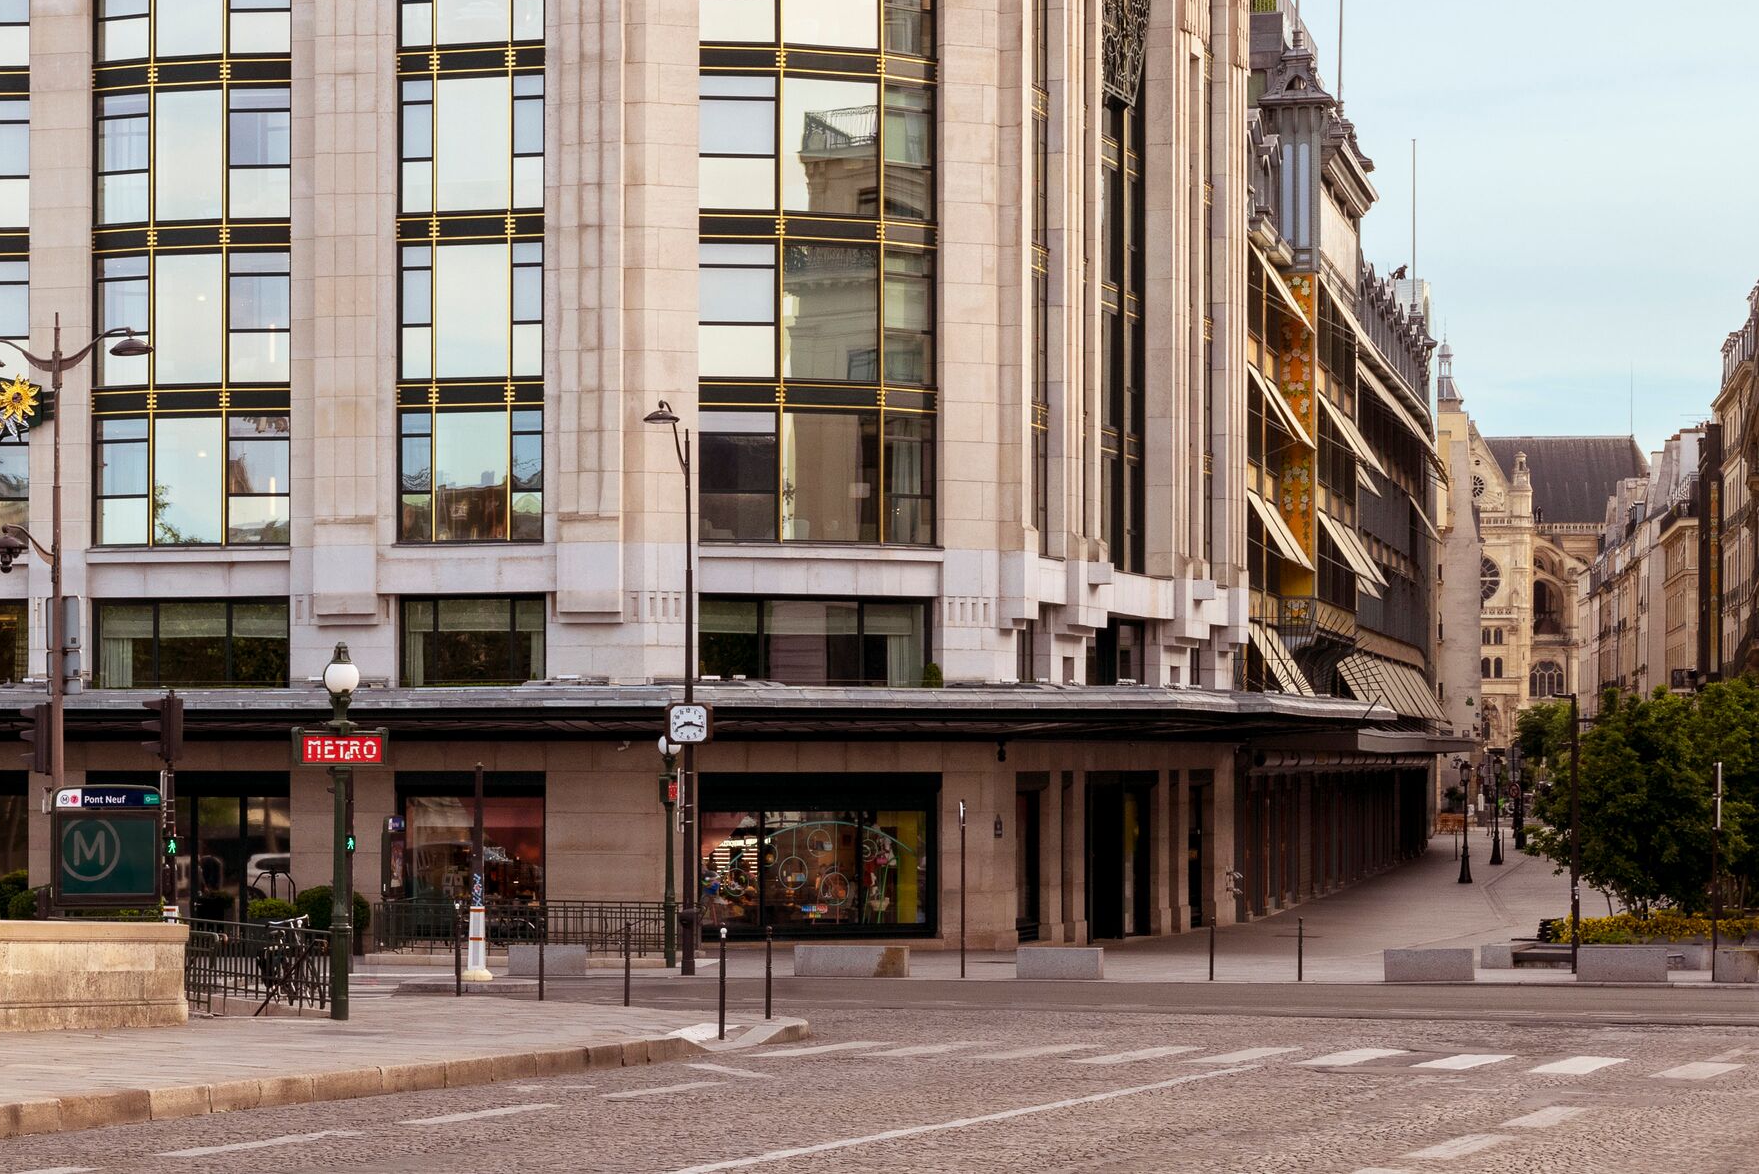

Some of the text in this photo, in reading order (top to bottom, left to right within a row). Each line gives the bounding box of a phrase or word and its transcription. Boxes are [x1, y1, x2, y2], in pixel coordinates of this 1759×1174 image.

[307, 740, 377, 759] METRO
[84, 795, 104, 804] Pont
[105, 794, 127, 804] Neuf
[73, 829, 106, 867] M
